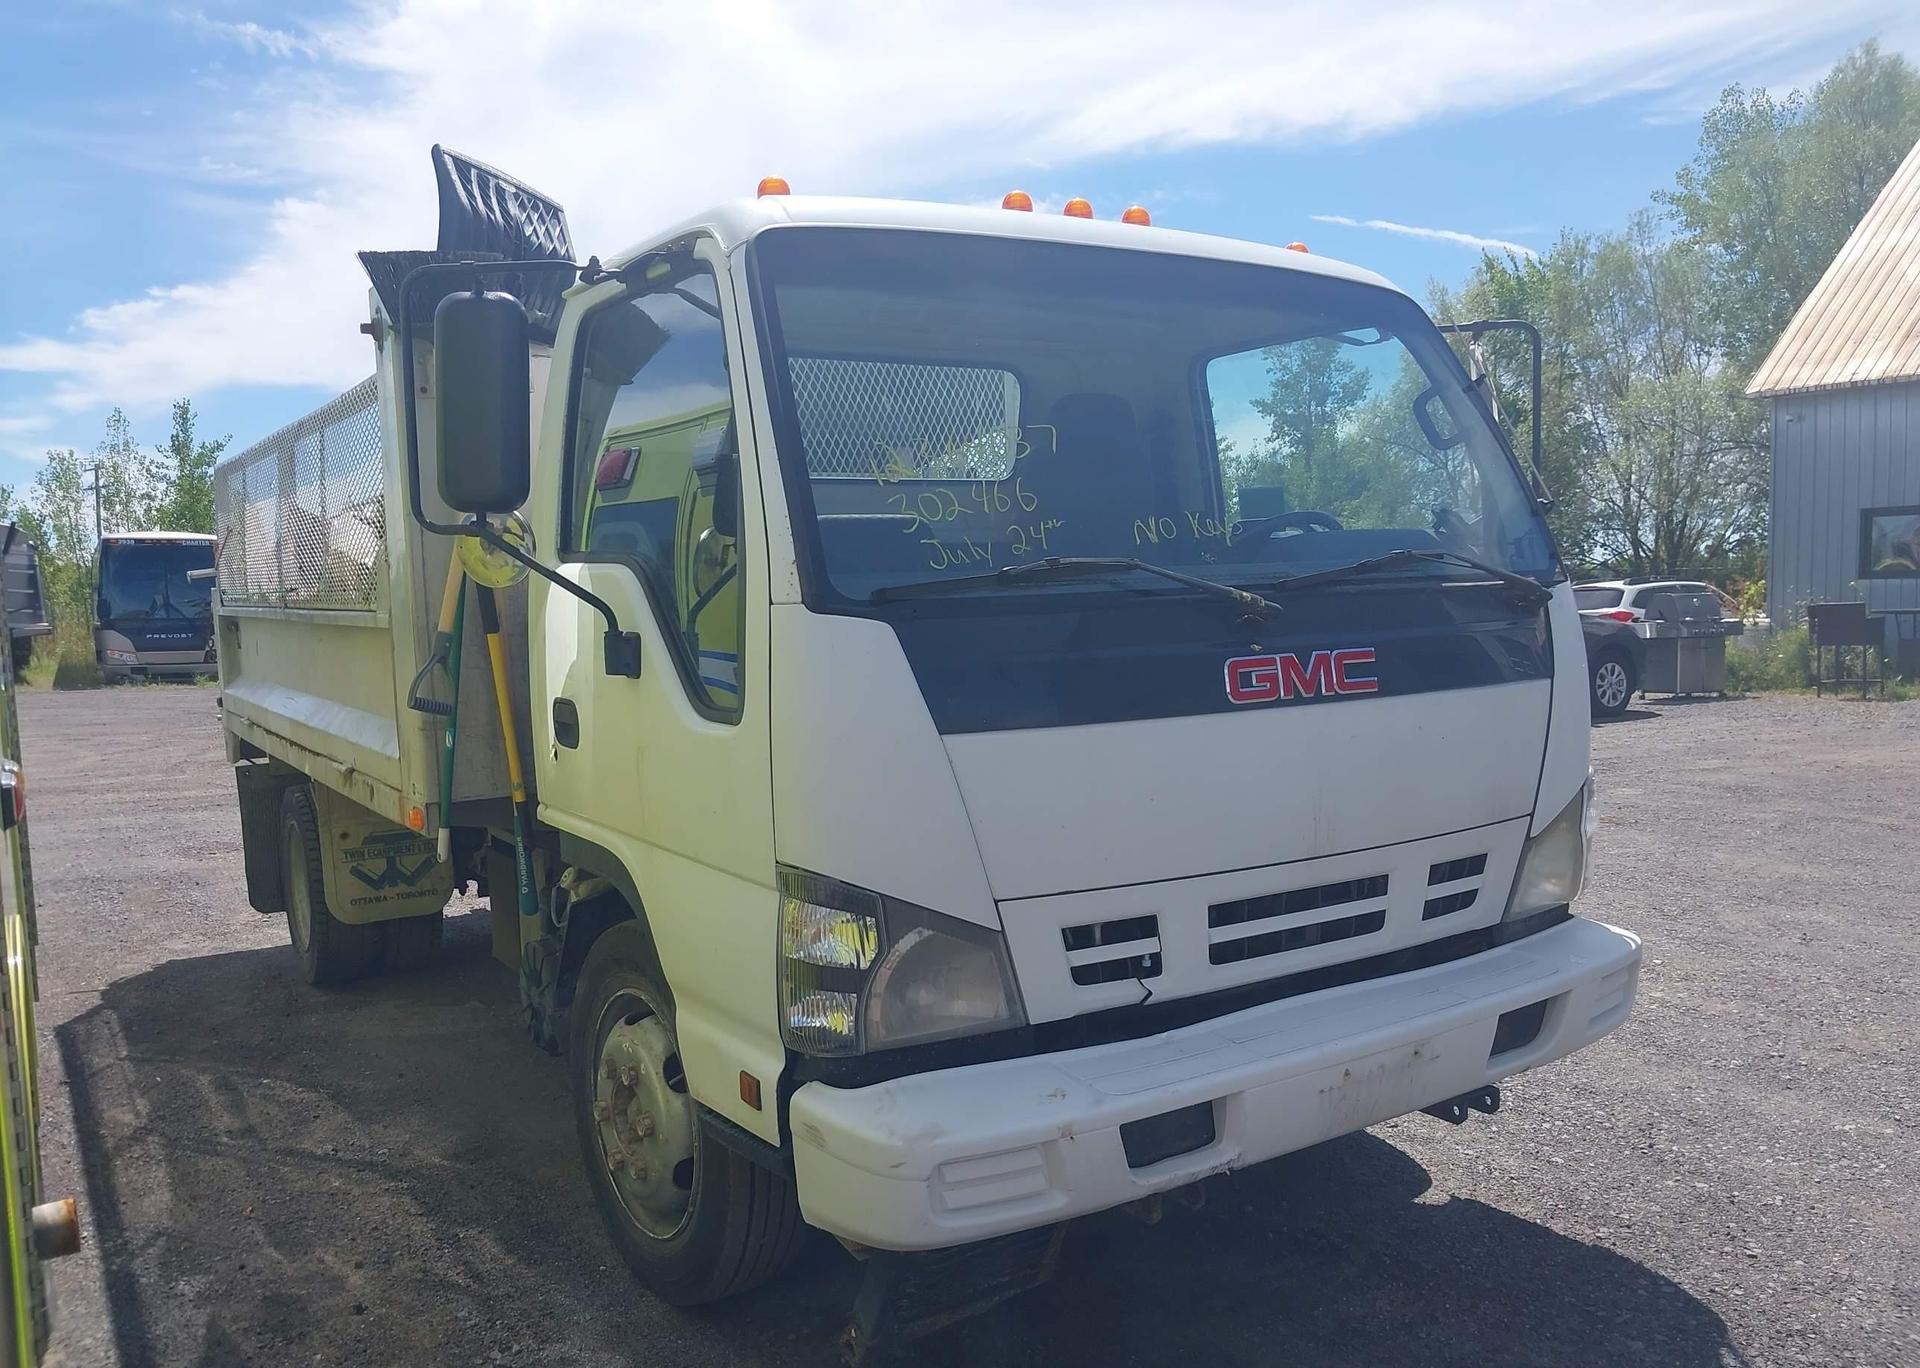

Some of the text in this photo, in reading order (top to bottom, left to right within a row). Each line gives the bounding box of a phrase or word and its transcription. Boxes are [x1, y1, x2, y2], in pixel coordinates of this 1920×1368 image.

[920, 536, 993, 570] July
[1224, 647, 1379, 705] GMC
[343, 848, 366, 861] TWIN
[350, 895, 388, 906] OTTAWA
[395, 888, 439, 901] TORONTO
